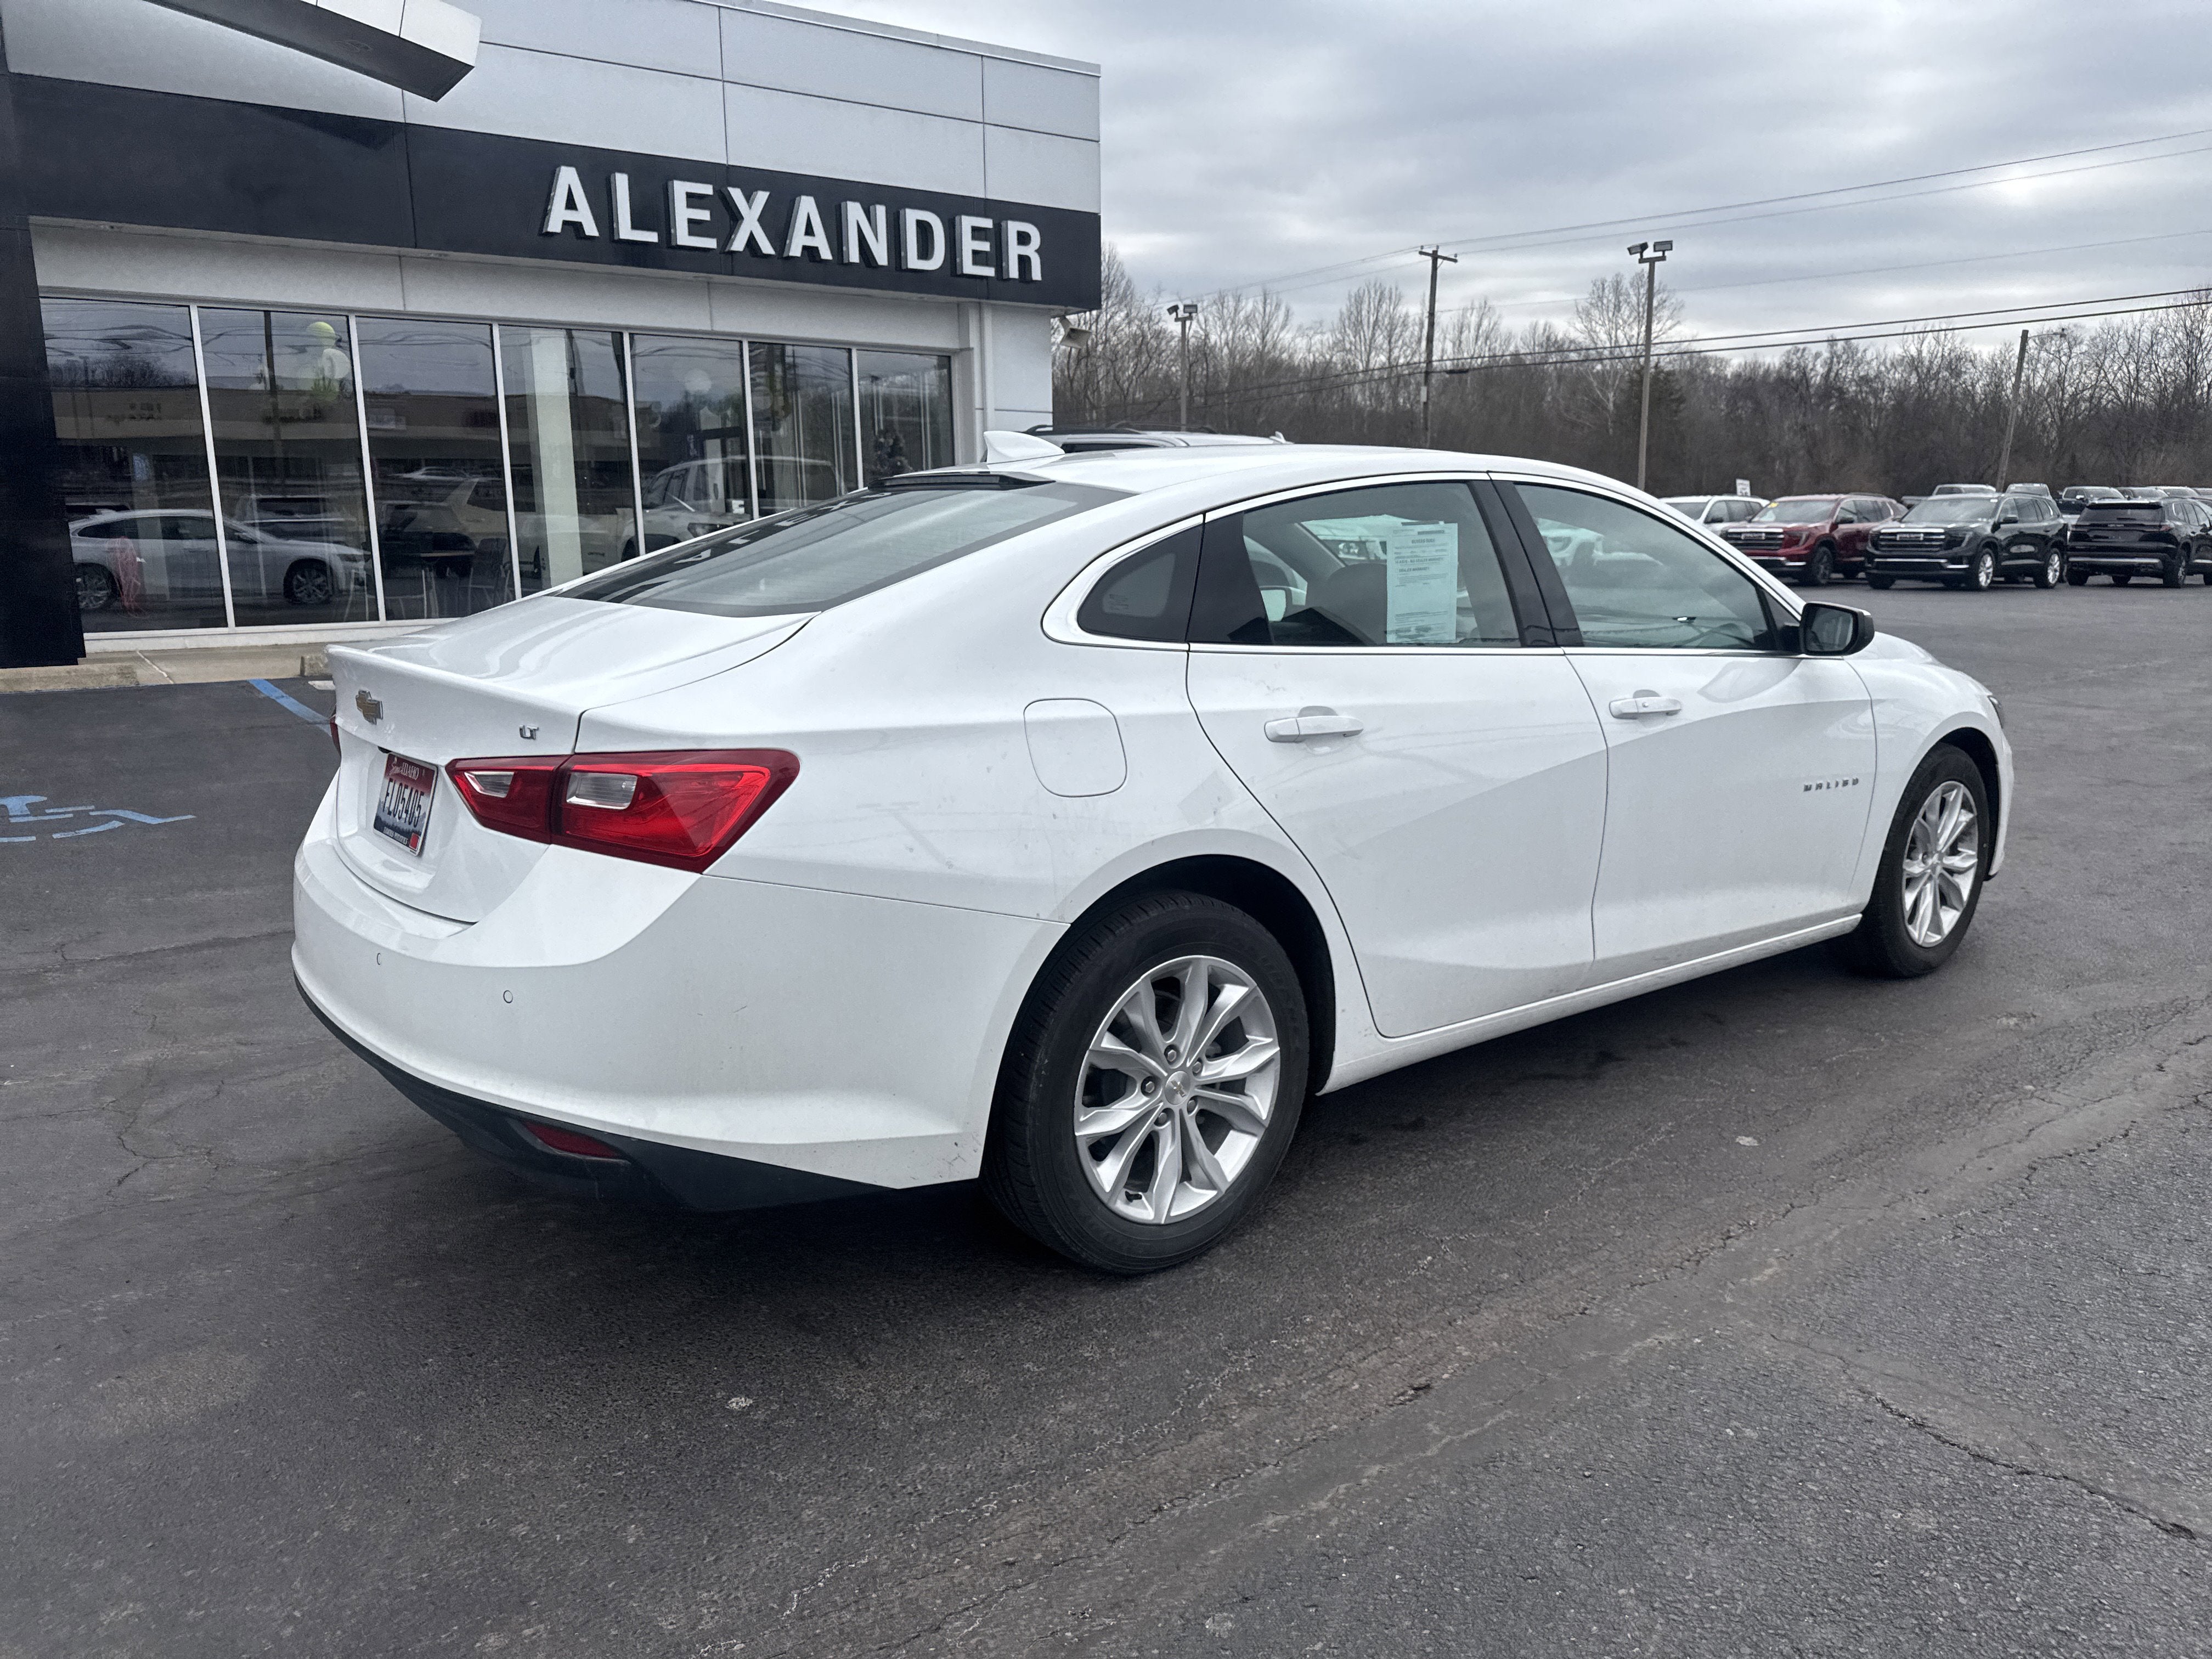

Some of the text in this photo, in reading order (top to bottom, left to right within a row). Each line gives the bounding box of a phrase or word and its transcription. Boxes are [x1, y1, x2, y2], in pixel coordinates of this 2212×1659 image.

[543, 166, 1042, 280] ALEXANDER
[518, 725, 539, 740] LT
[382, 777, 425, 828] FL05405
